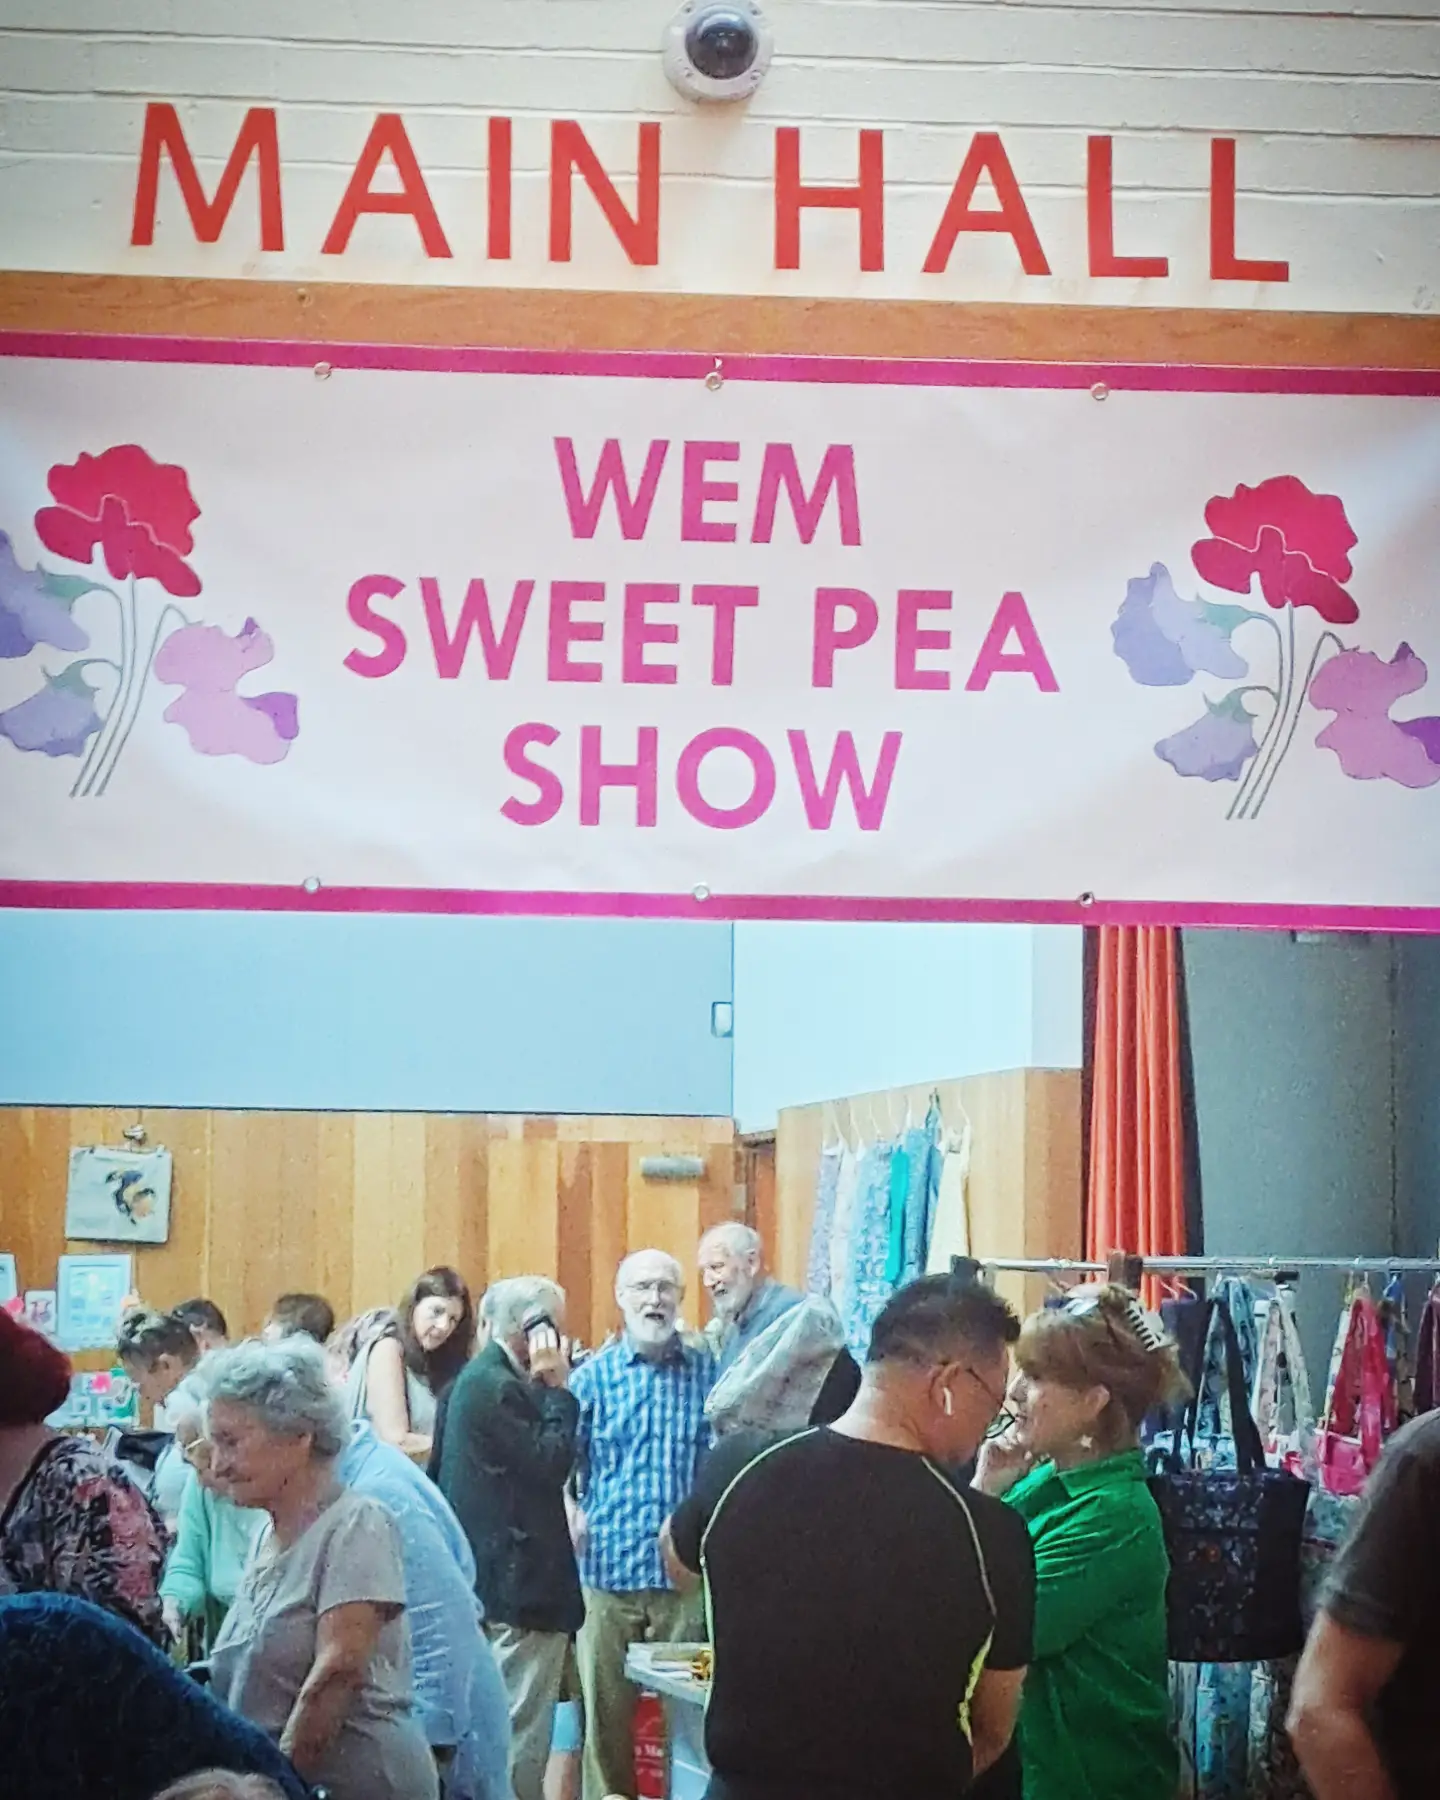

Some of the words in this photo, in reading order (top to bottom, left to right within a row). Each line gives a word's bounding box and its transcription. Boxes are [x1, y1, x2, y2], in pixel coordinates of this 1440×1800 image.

[131, 103, 660, 266] MAIN
[776, 128, 1289, 281] HALL
[555, 437, 861, 546] WEM
[344, 575, 759, 686] SWEET
[814, 588, 1058, 692] PEA
[501, 723, 902, 830] SHOW
